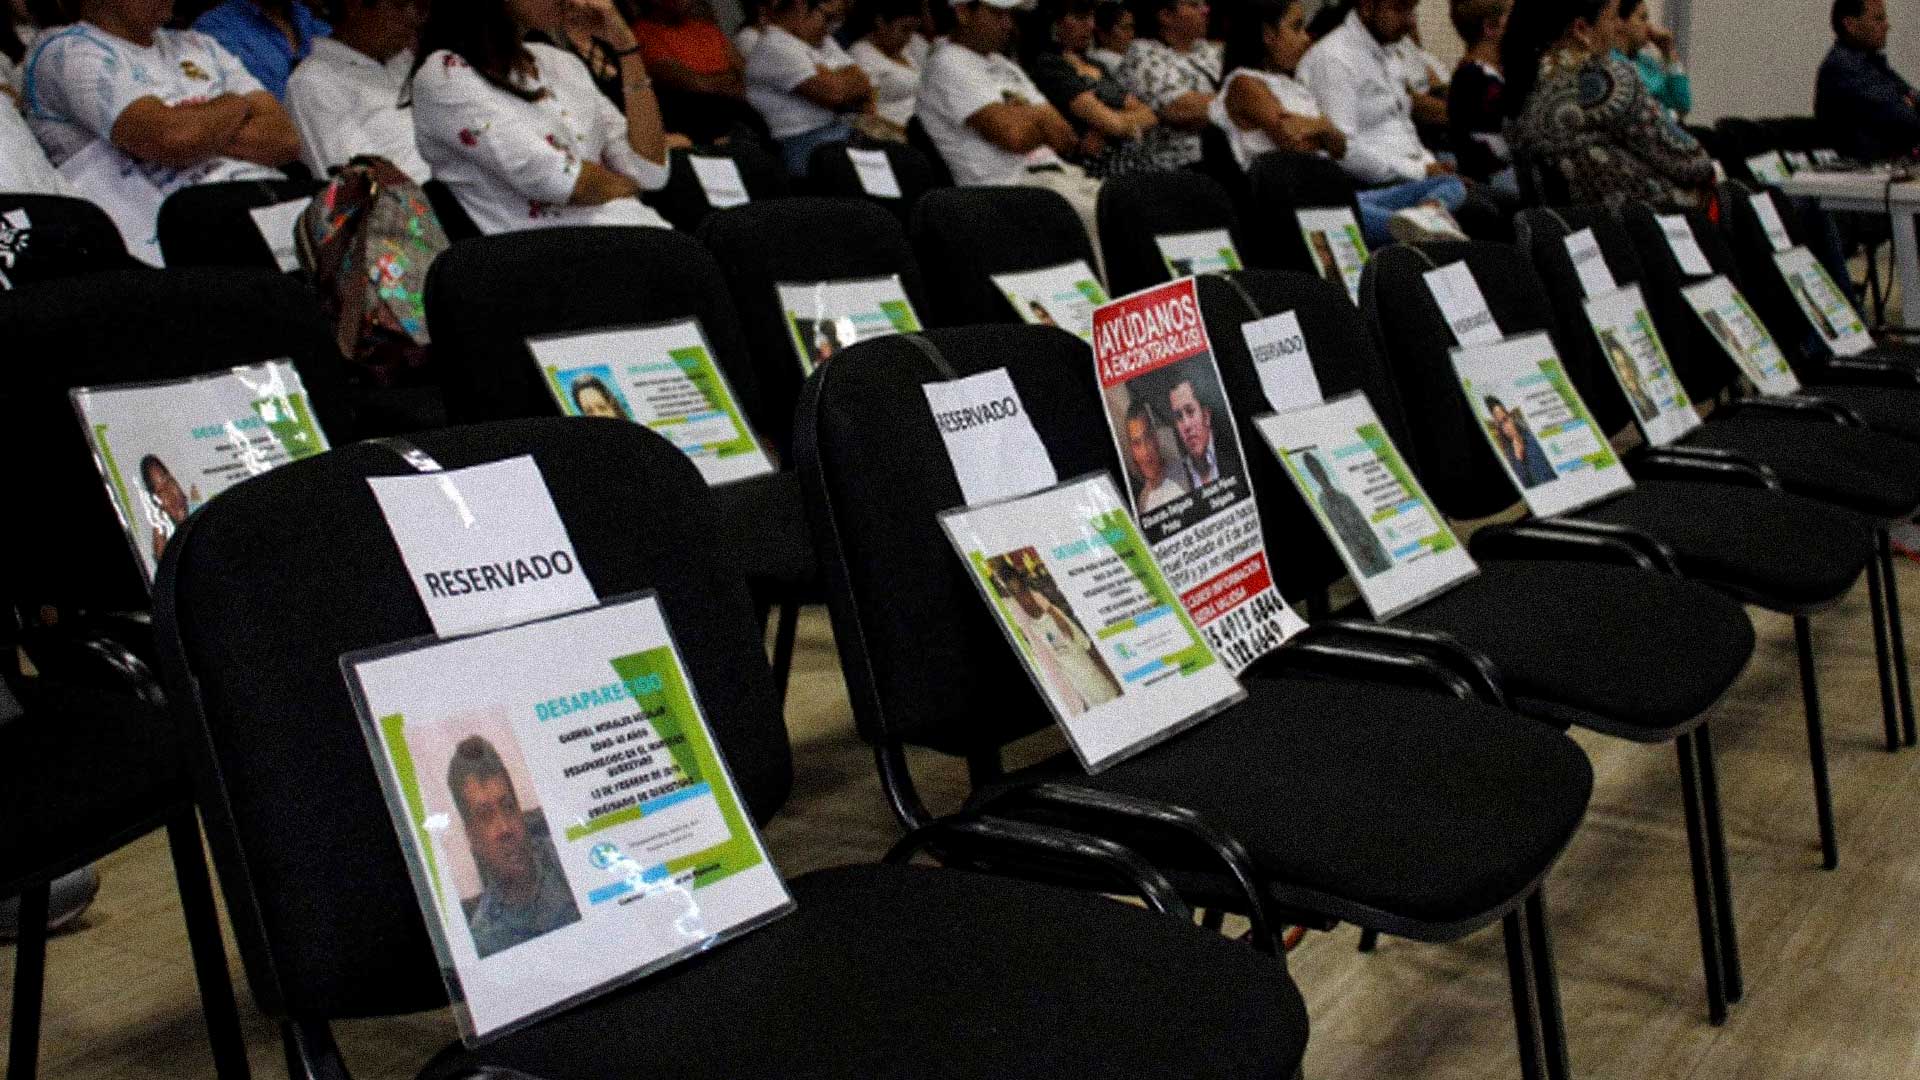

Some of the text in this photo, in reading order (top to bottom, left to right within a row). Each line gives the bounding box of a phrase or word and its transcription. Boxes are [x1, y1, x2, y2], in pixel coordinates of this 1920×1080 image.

[1103, 359, 1116, 381] A
[935, 396, 1019, 433] RESERVADO
[424, 550, 574, 598] RESERVADO
